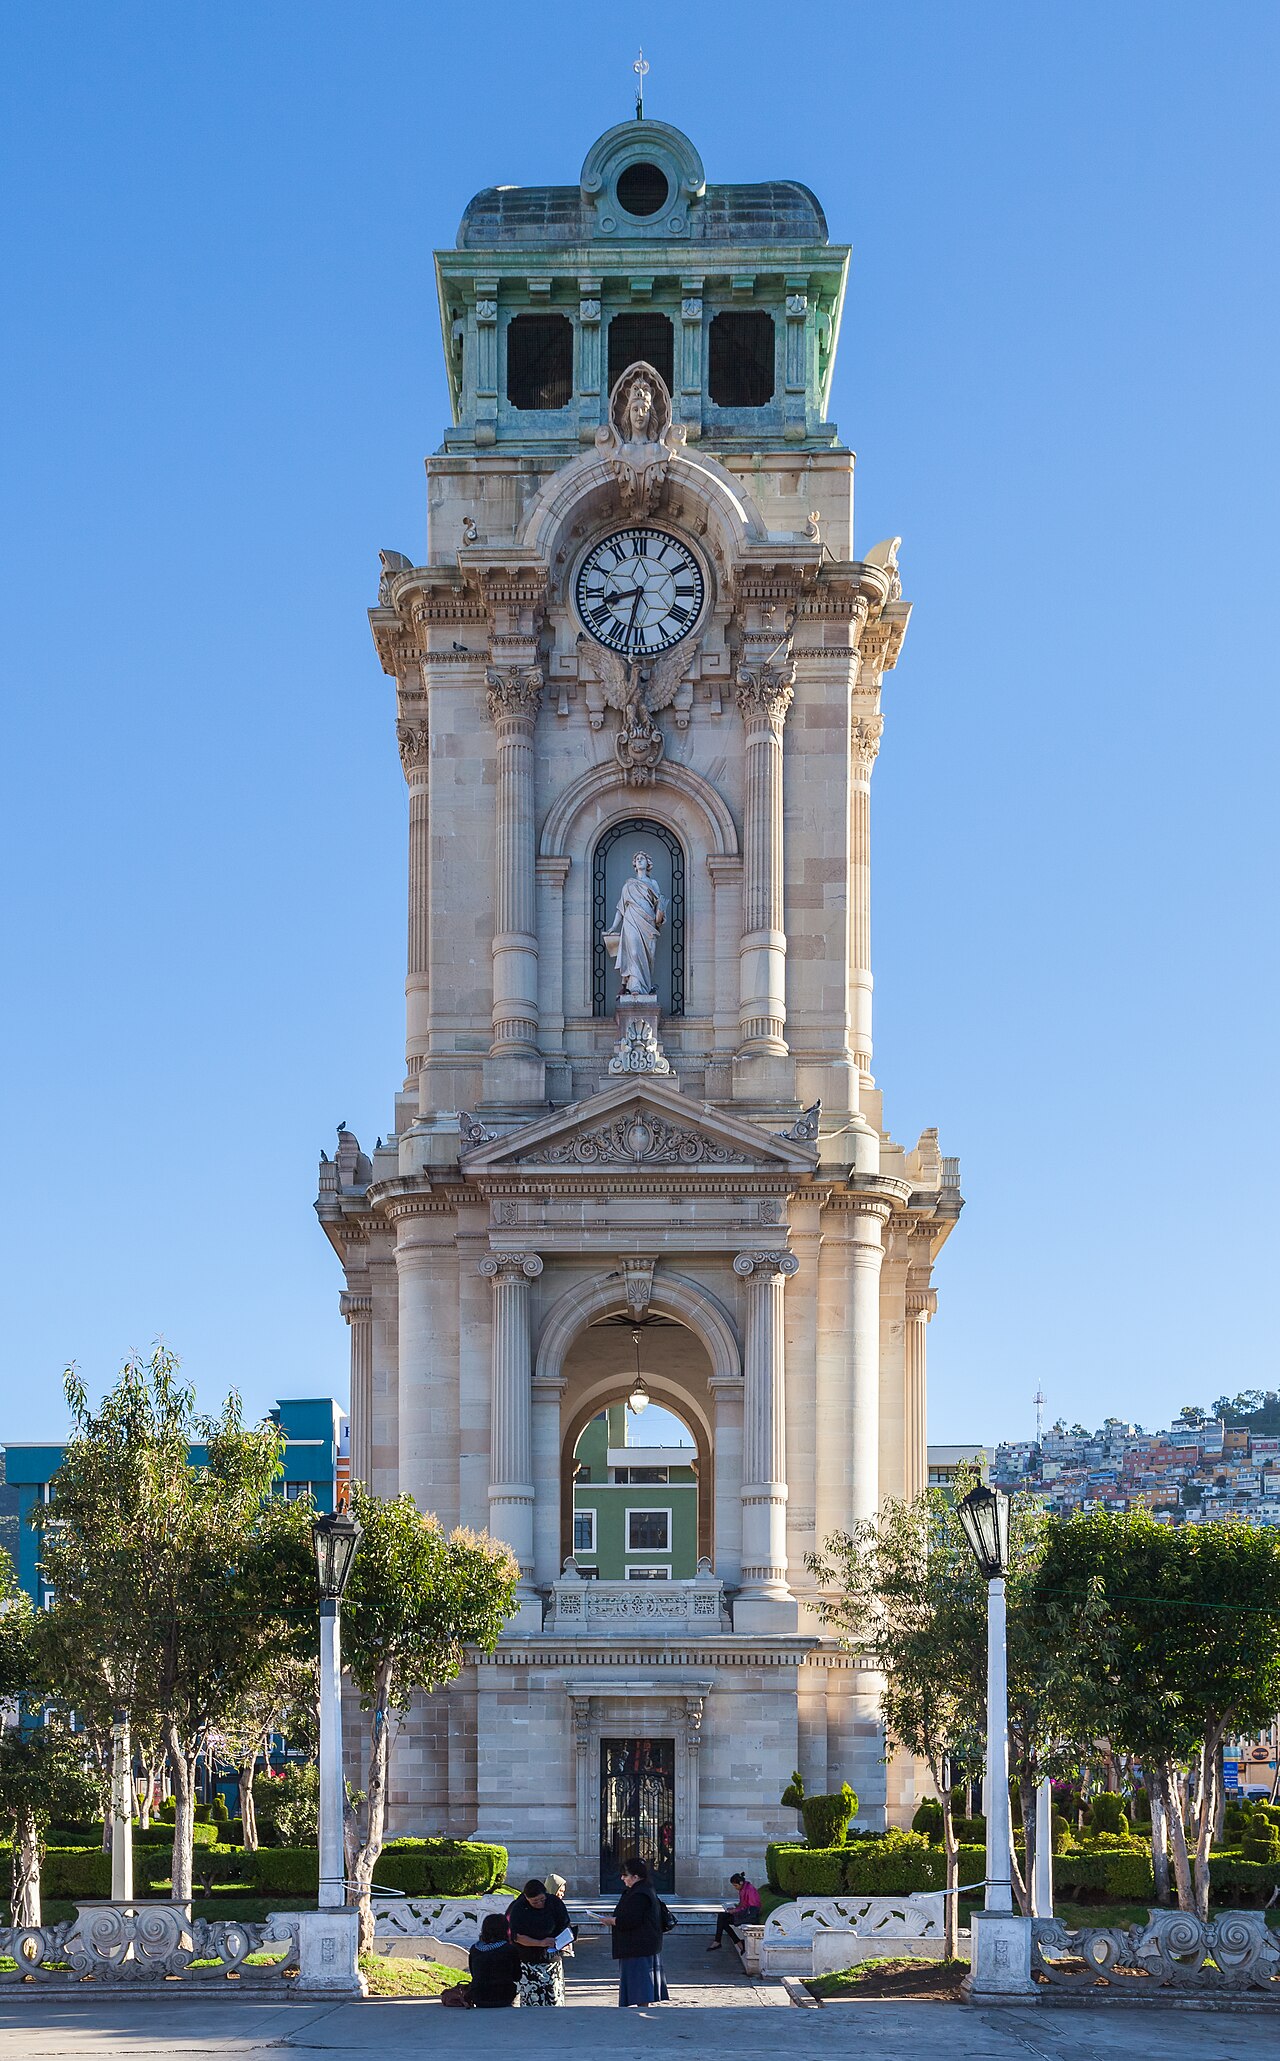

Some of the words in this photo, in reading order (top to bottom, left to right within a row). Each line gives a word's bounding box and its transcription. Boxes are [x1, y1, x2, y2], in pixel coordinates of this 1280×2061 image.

[609, 543, 627, 564] XI
[632, 537, 647, 556] XII
[657, 544, 669, 560] I
[591, 561, 610, 577] X
[670, 560, 690, 576] II
[586, 585, 604, 599] IX
[675, 586, 694, 597] III
[589, 603, 613, 627] VIII
[669, 603, 690, 624] IIII
[607, 620, 626, 640] VII
[634, 627, 646, 646] VI
[657, 622, 671, 640] V
[626, 1051, 655, 1069] 1859
